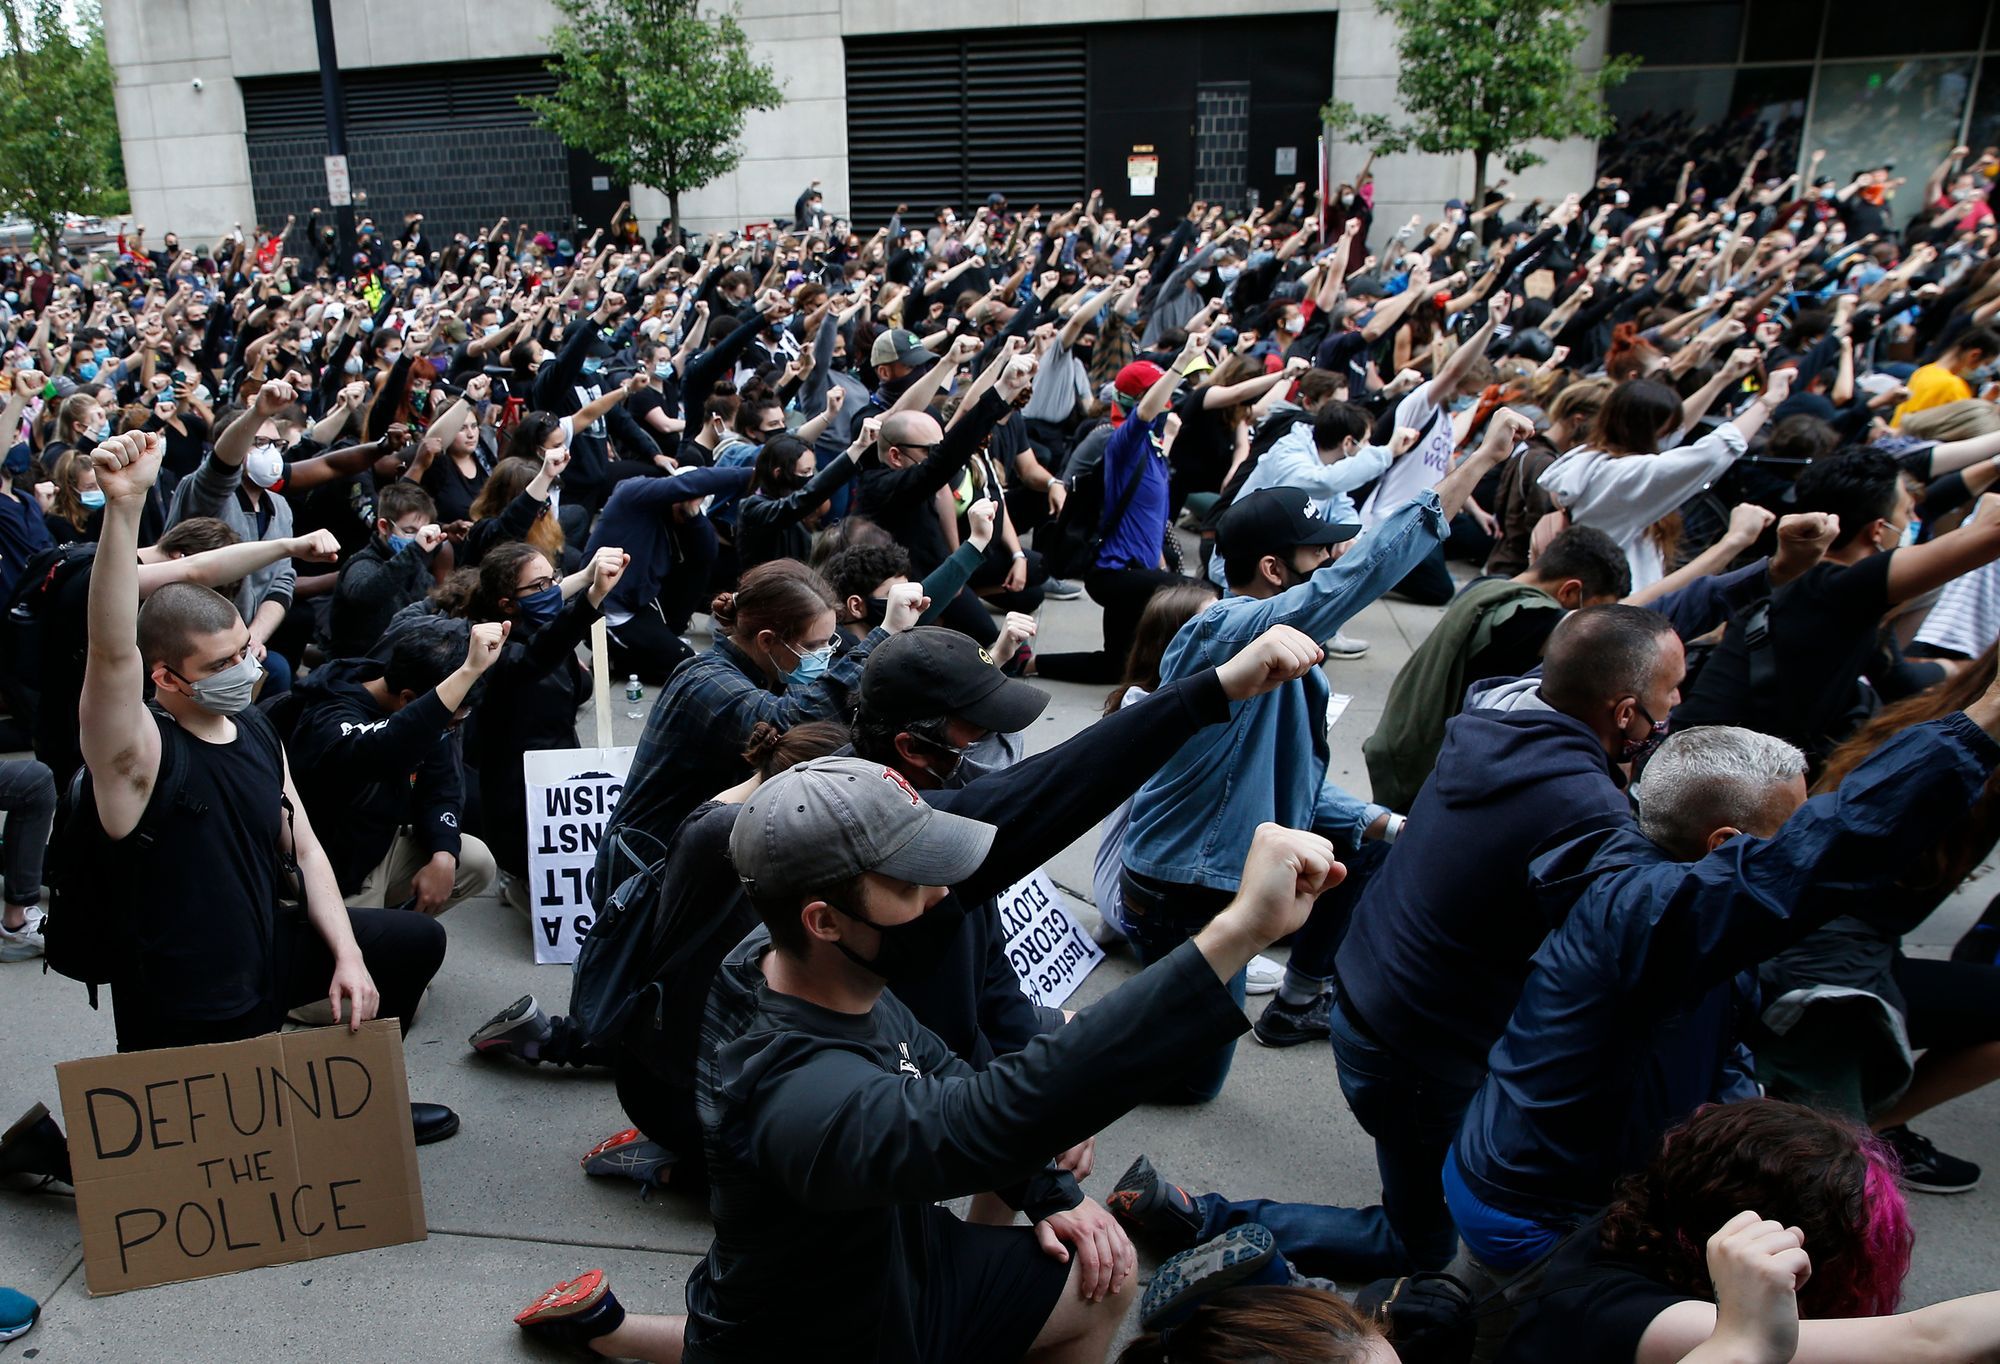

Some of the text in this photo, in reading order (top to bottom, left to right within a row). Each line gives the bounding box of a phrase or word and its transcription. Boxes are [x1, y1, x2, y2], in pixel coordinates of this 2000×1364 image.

[546, 785, 624, 817] CISM
[882, 767, 919, 806] B
[538, 822, 608, 854] NST
[540, 914, 593, 947] S A
[1010, 908, 1069, 978] GEORG
[1038, 926, 1095, 994] Justice
[85, 1055, 372, 1160] DEFUND
[198, 1150, 274, 1188] THE
[115, 1179, 366, 1275] POLICE
